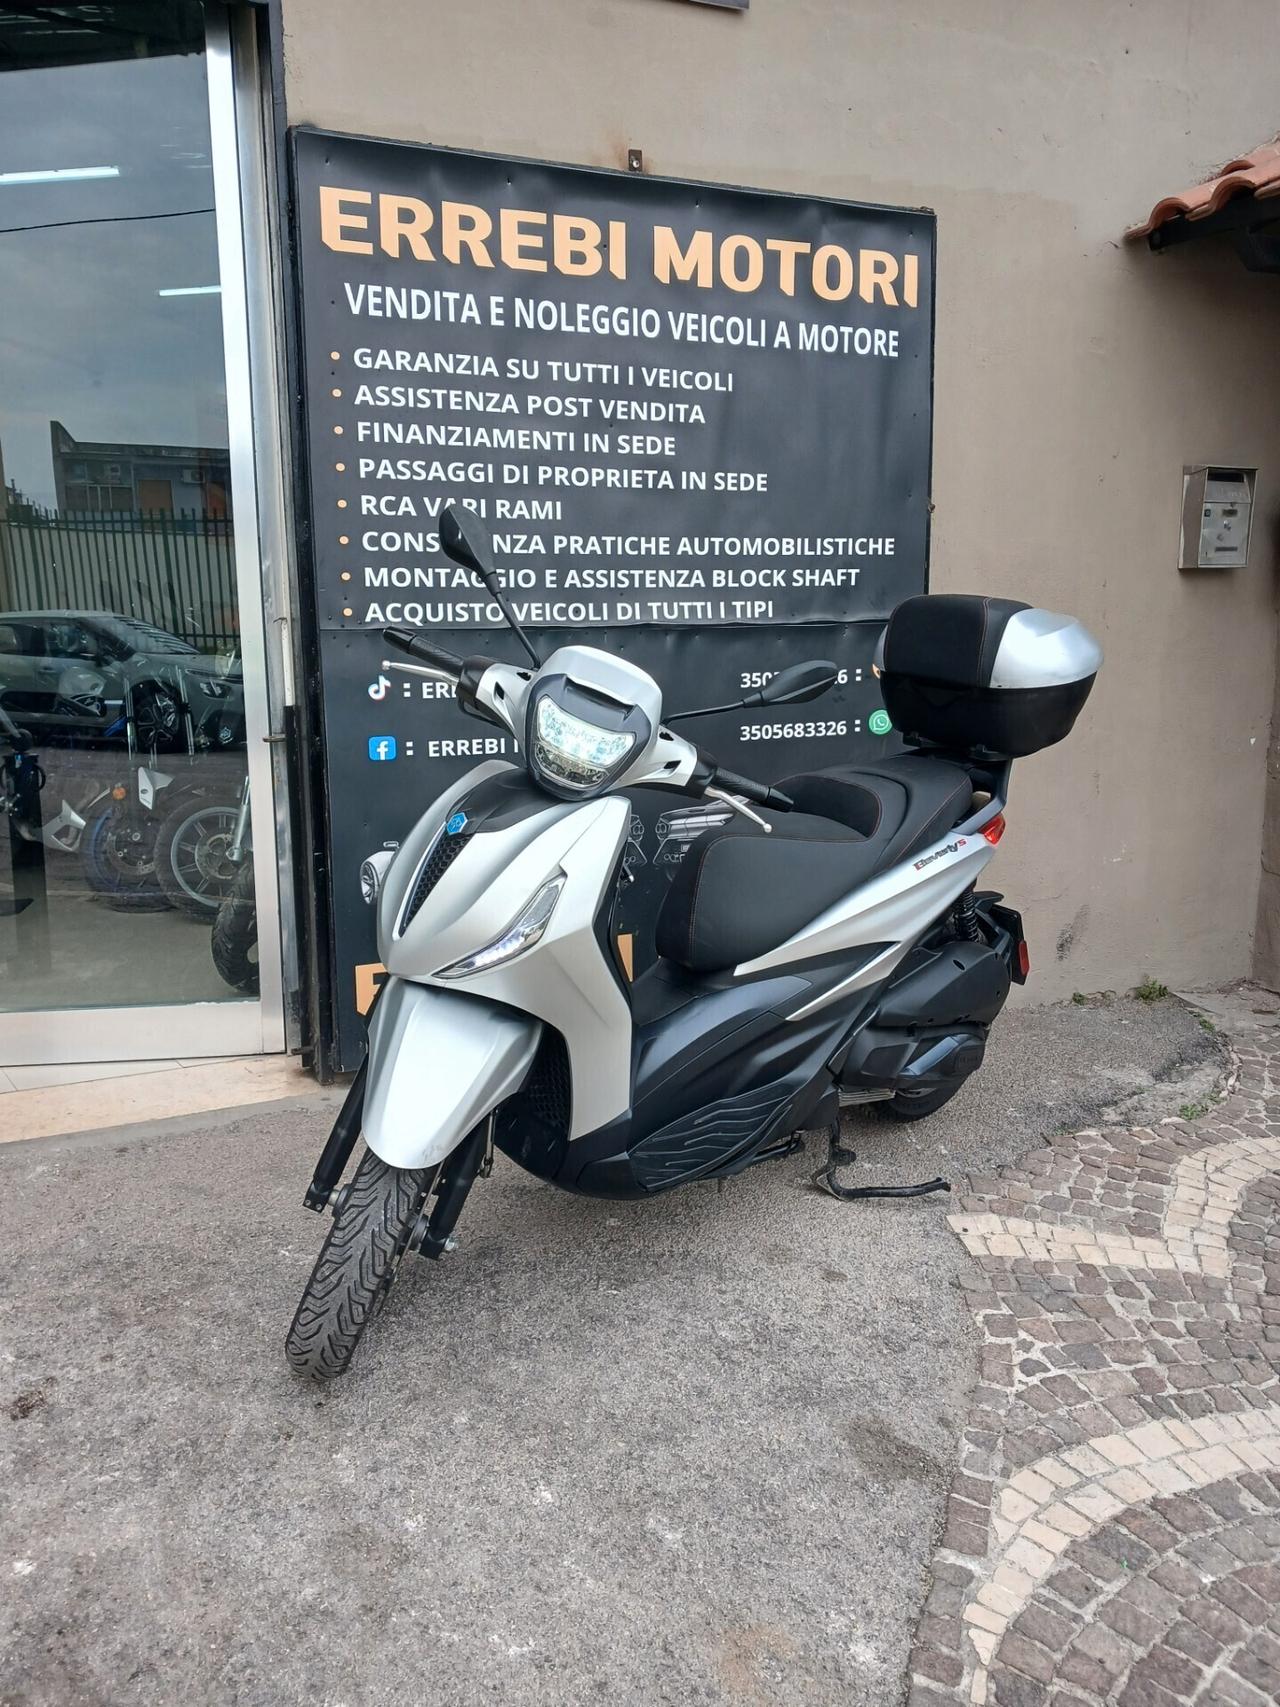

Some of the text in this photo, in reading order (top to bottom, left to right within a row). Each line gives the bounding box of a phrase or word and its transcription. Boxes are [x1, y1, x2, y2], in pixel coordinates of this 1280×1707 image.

[319, 185, 919, 308] ERREBI MOTORI
[343, 282, 899, 358] VENDITA E NOLEGGIO VEICOLI A MOTORE
[353, 347, 733, 393] GARANZIA SU TUTTI I VEICOLI
[354, 384, 706, 425] ASSISTENZA POST VENDITA
[357, 420, 676, 456] FINANZIAMENTI IN SEDE
[359, 457, 768, 492] PASSAGGI DI PROPRIETA IN SEDE
[360, 494, 418, 517] RCA
[495, 499, 562, 521] RAMI
[361, 531, 895, 556] CONSNZA PRATICHE AUTOMOBILISTICHE
[544, 569, 558, 589] E
[563, 569, 706, 589] ASSISTENZA
[712, 569, 787, 588] BLOCK
[791, 568, 861, 587] SHAFT
[364, 600, 773, 627] ACQUISTO VEICOLI DI TUTTI I TIPI
[739, 720, 848, 741] 3505683326
[428, 737, 506, 758] ERREBI
